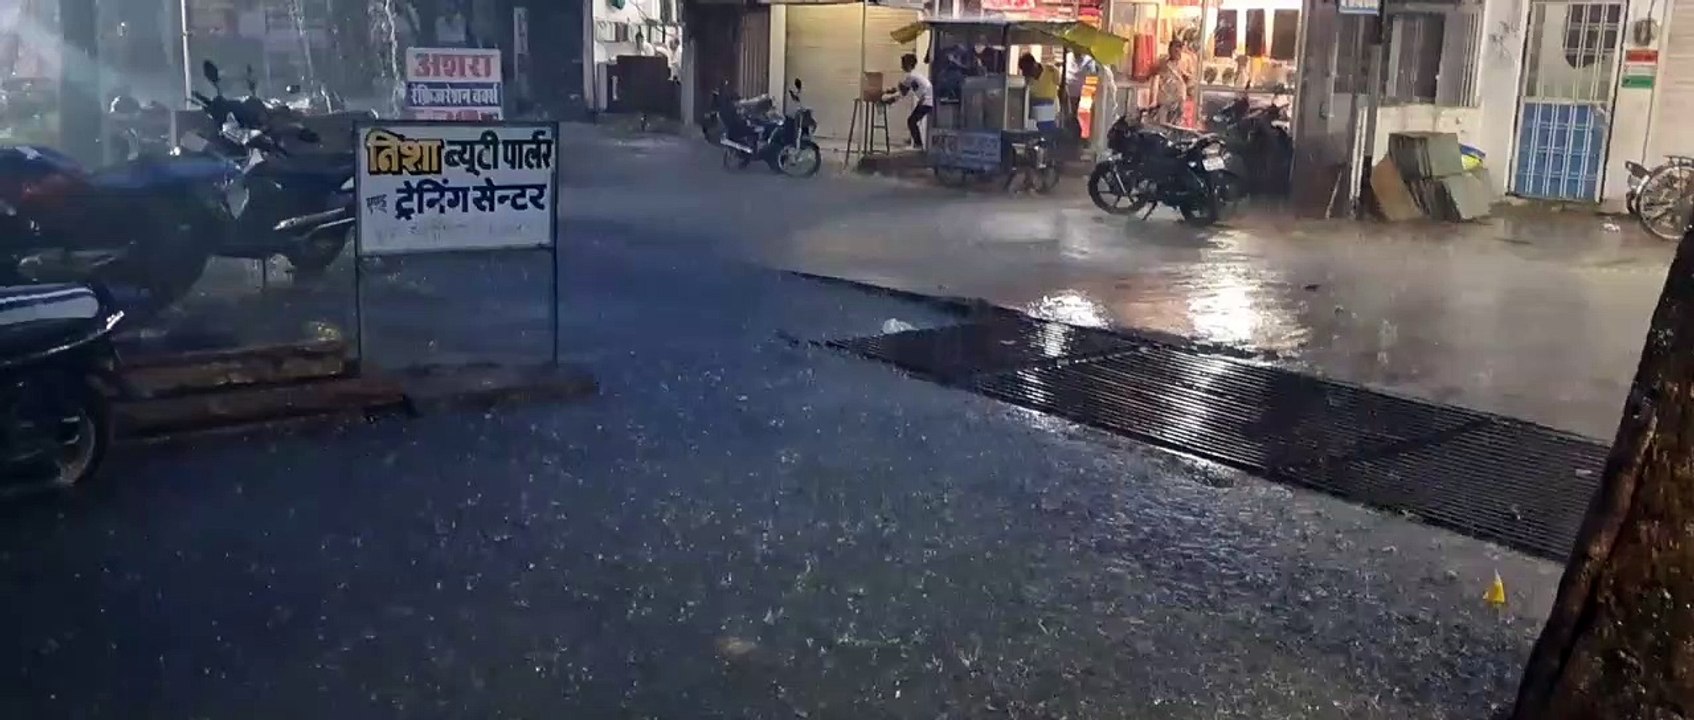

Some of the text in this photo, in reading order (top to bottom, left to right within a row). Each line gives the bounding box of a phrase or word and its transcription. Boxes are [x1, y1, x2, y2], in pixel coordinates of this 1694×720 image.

[444, 130, 499, 176] ब्यूटी
[502, 130, 553, 170] पार्लर
[395, 178, 470, 221] ट्रेनिंग
[472, 177, 547, 213] सेन्टर
